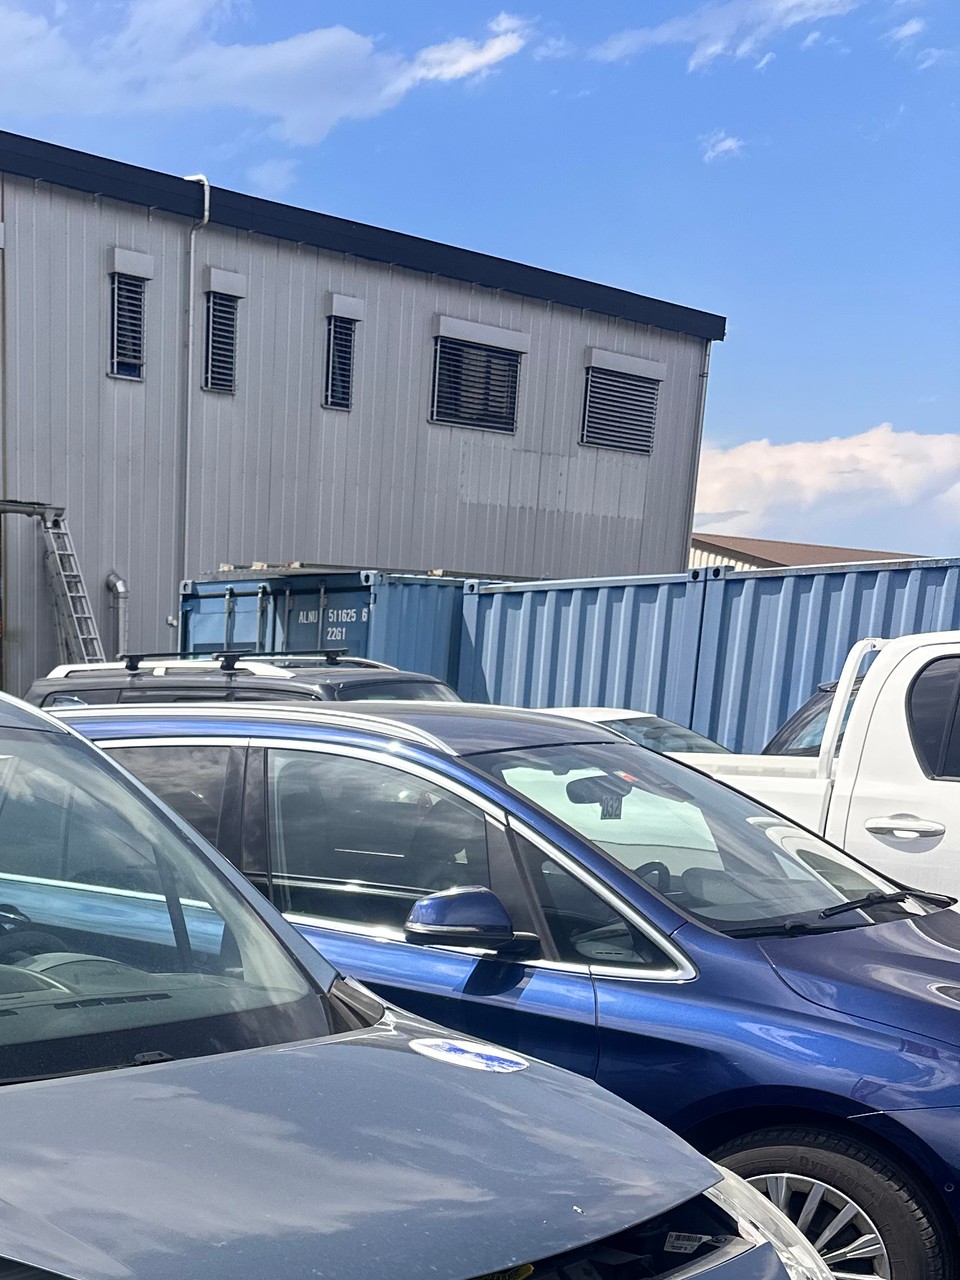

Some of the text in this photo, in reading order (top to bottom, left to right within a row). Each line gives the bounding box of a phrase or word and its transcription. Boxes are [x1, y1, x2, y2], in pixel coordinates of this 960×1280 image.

[298, 607, 368, 623] ALNU 511625 6
[326, 626, 346, 640] 22G1
